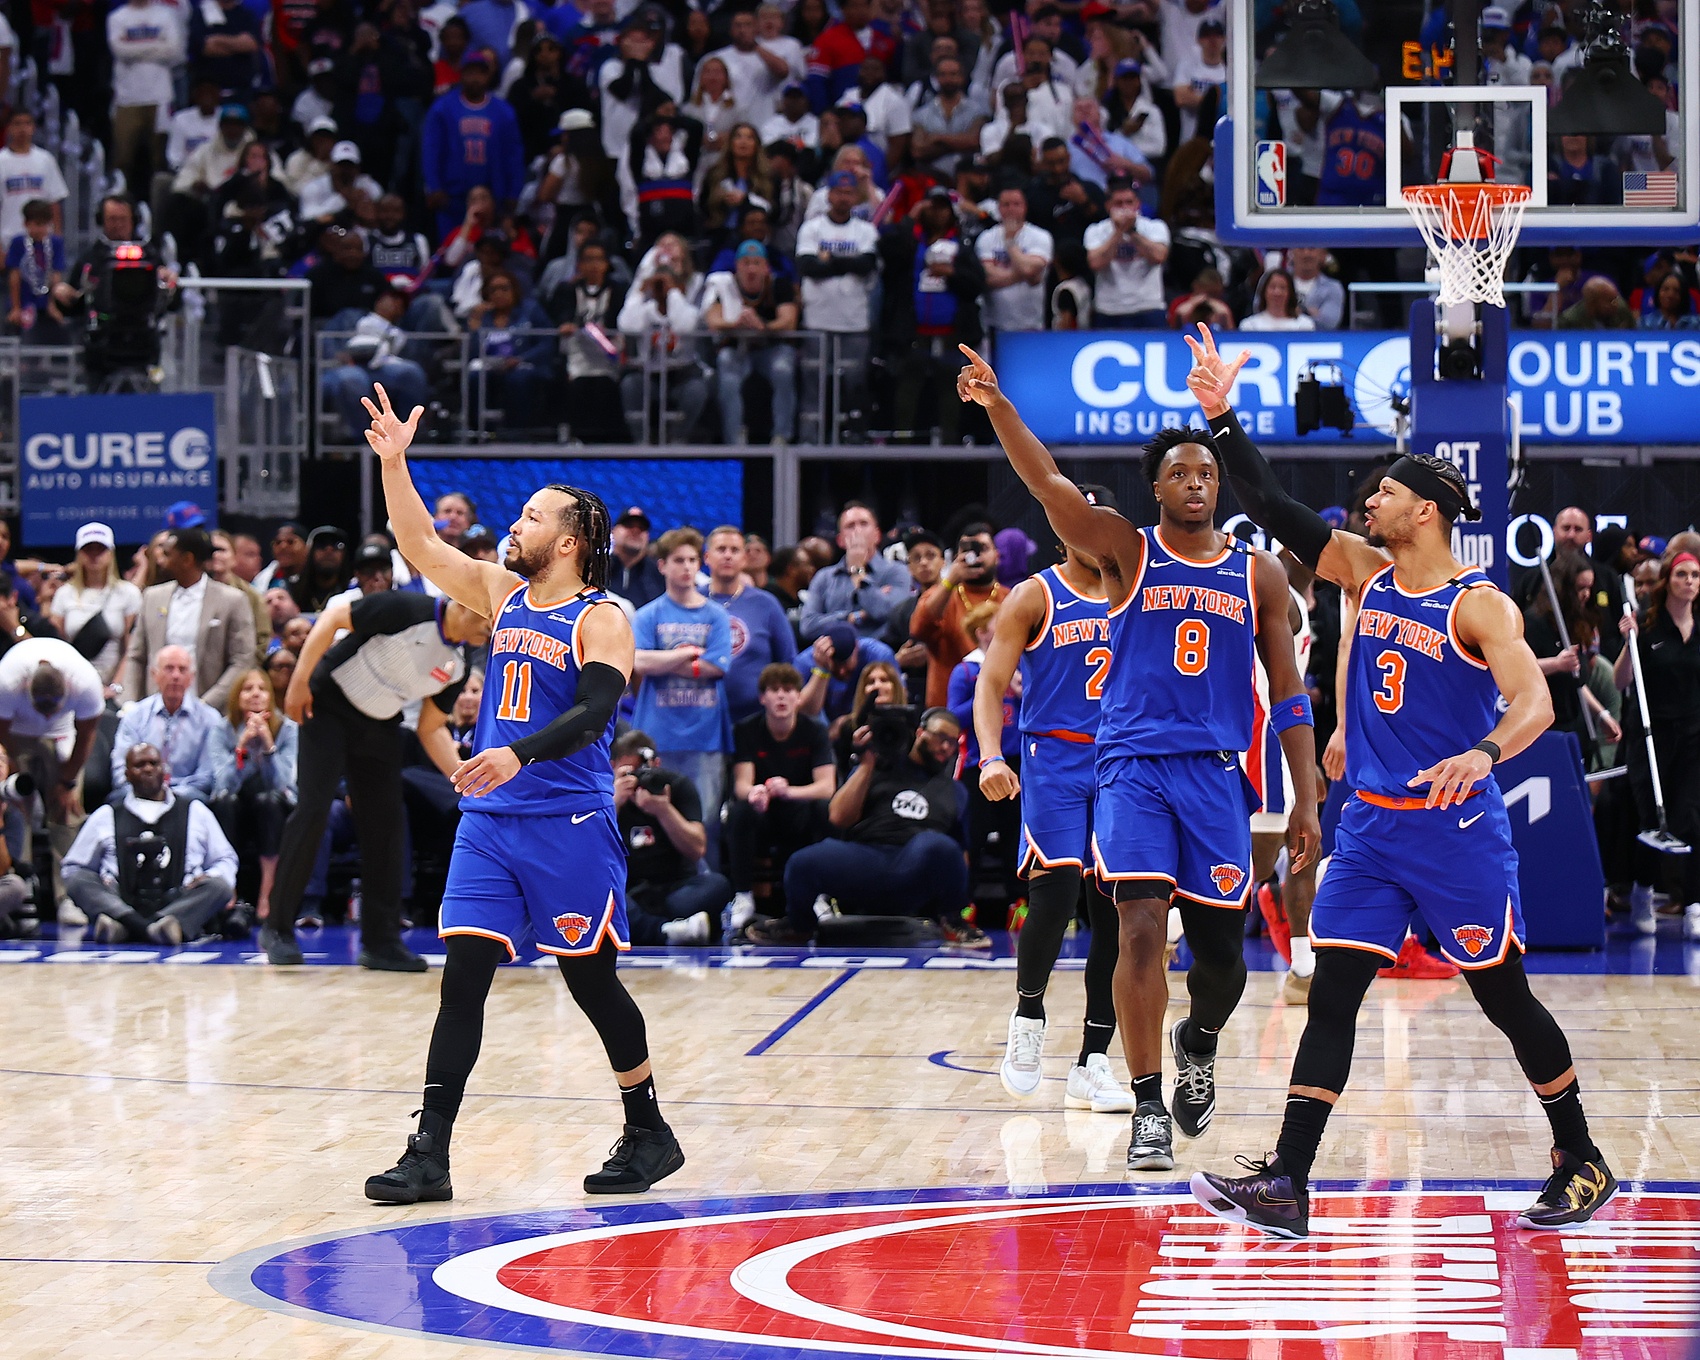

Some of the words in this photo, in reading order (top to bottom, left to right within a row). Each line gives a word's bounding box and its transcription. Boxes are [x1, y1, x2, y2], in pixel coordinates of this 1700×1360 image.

[1336, 148, 1375, 180] 30
[1508, 340, 1700, 387] OURTS
[1074, 410, 1275, 435] INSURACE
[1510, 390, 1623, 436] LUB
[25, 432, 166, 470] CURE
[27, 473, 83, 490] AUTO
[89, 470, 212, 488] INSURANCE
[1142, 585, 1193, 612] NEW
[1193, 586, 1247, 625] YORK
[492, 628, 522, 657] NEW
[518, 628, 571, 672] YORK
[1052, 619, 1096, 648] NEW
[1173, 618, 1211, 676] 8
[1359, 609, 1398, 640] NEW
[1394, 616, 1449, 662] YORK
[496, 660, 532, 722] 11
[1085, 647, 1112, 700] 2
[1373, 650, 1408, 714] 3
[1128, 1215, 1507, 1341] PISTONS
